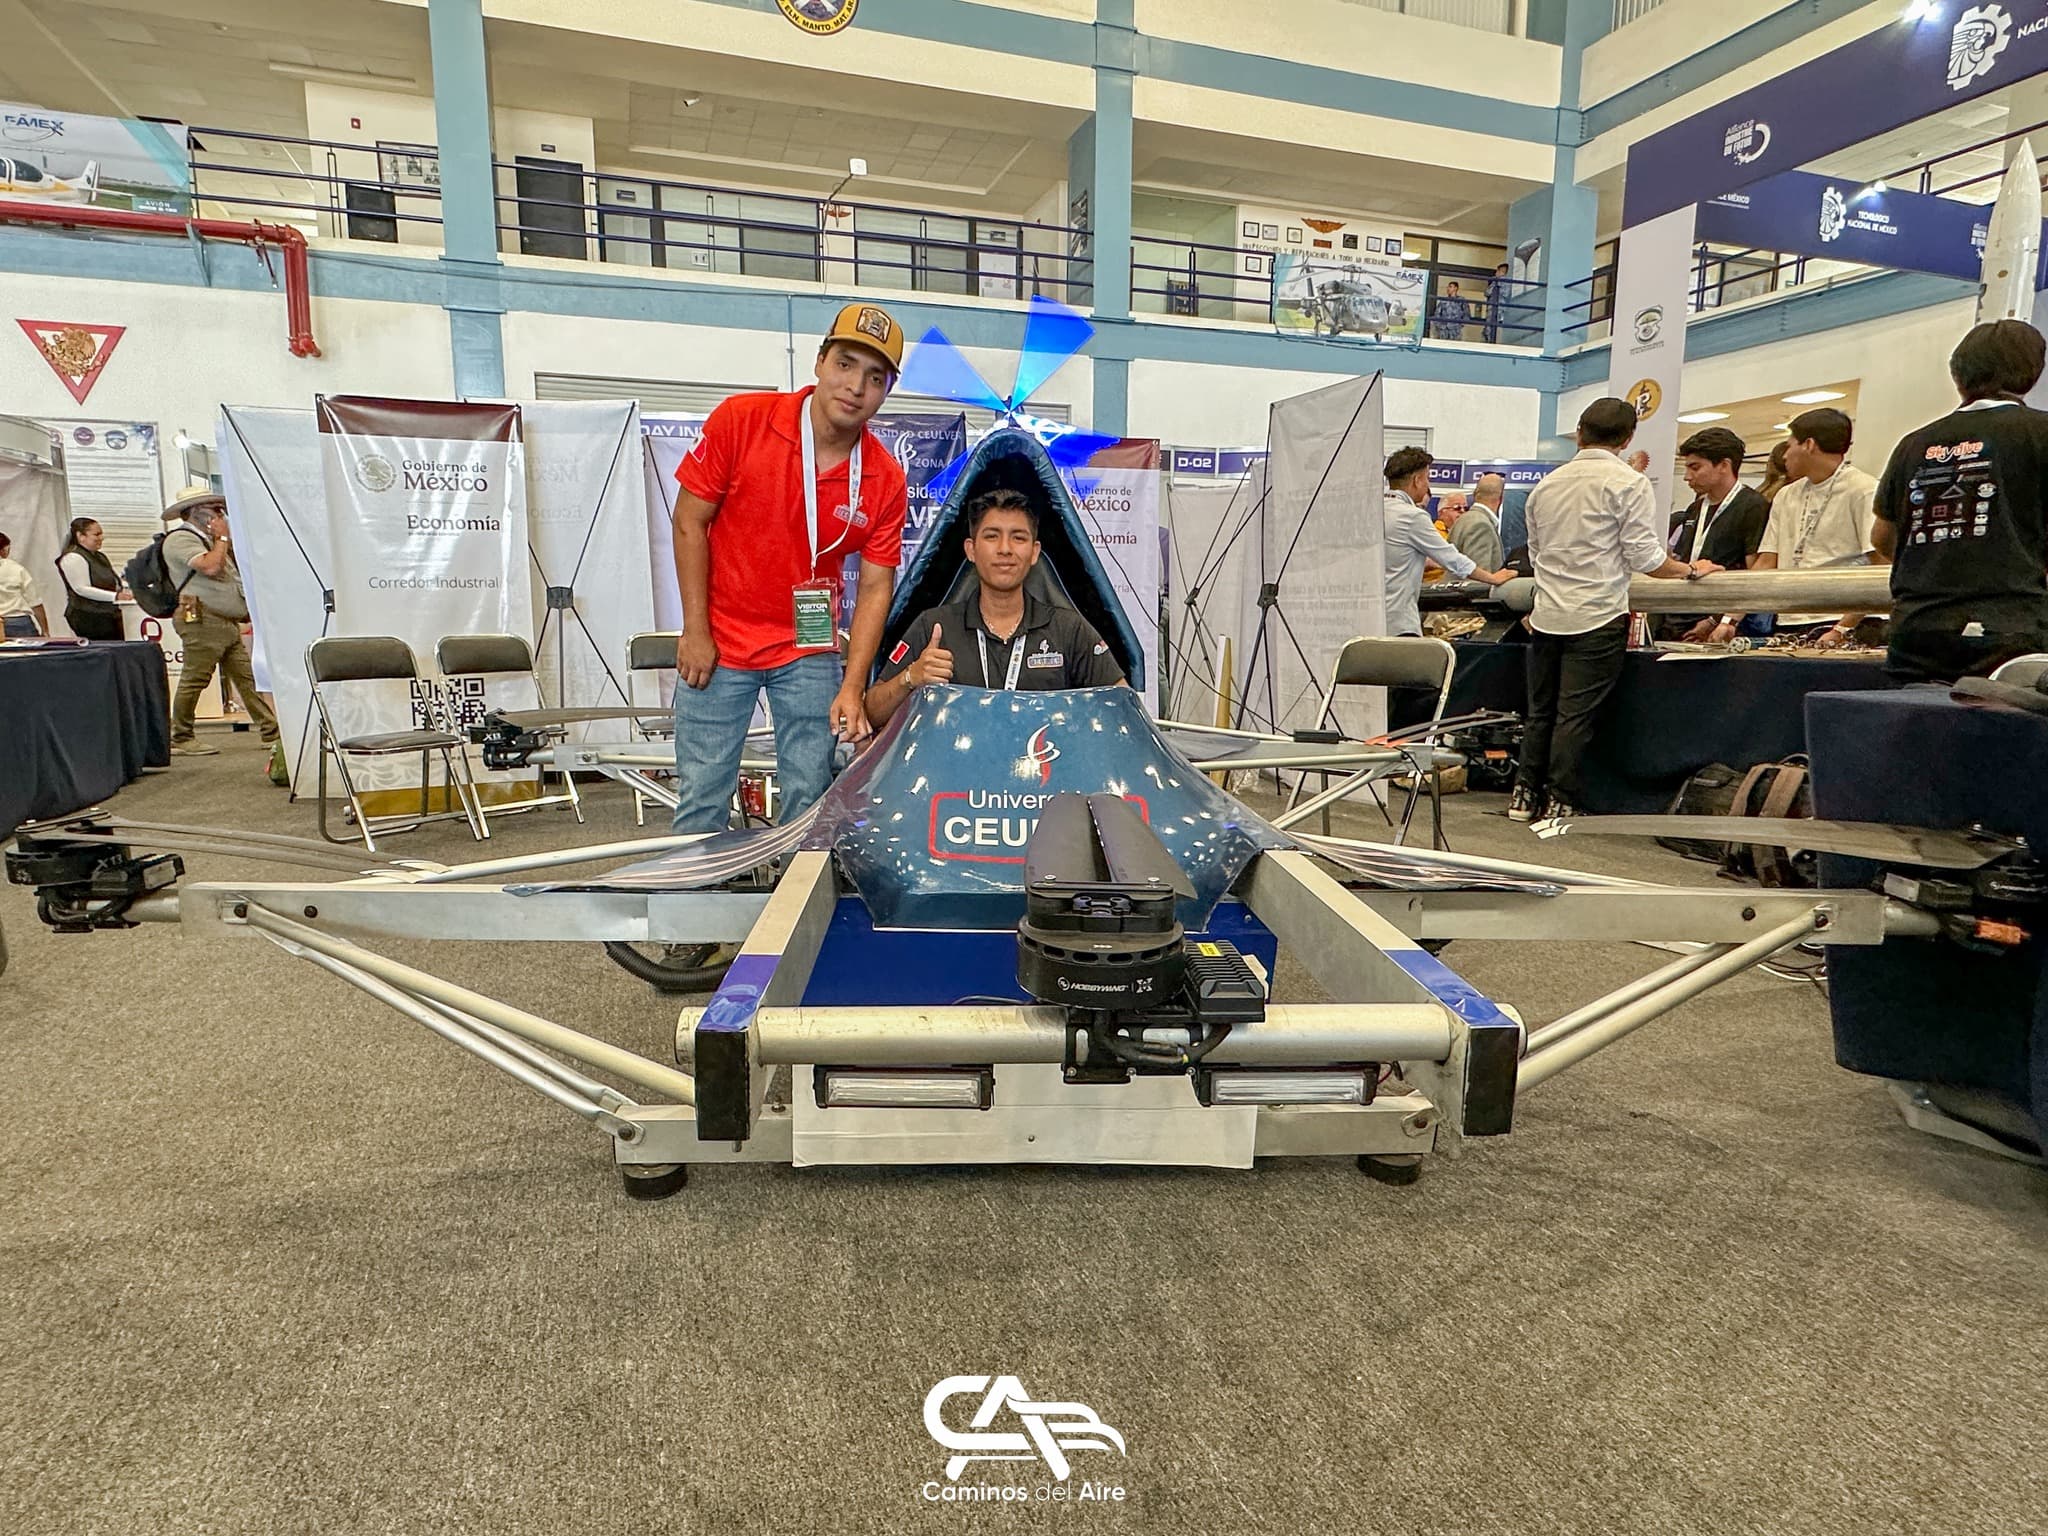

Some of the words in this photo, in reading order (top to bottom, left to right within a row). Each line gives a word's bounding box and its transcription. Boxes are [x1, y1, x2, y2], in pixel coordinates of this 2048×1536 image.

[679, 426, 702, 437] IN
[402, 460, 468, 472] Gobierno
[471, 462, 487, 473] de
[915, 458, 944, 468] ZONA
[1178, 457, 1212, 468] D-02
[1429, 469, 1457, 479] D-01
[403, 471, 488, 492] México
[1120, 486, 1132, 496] de
[1071, 495, 1131, 512] México
[407, 515, 500, 531] Economía
[368, 576, 433, 589] Corredor
[436, 577, 499, 589] Industrial
